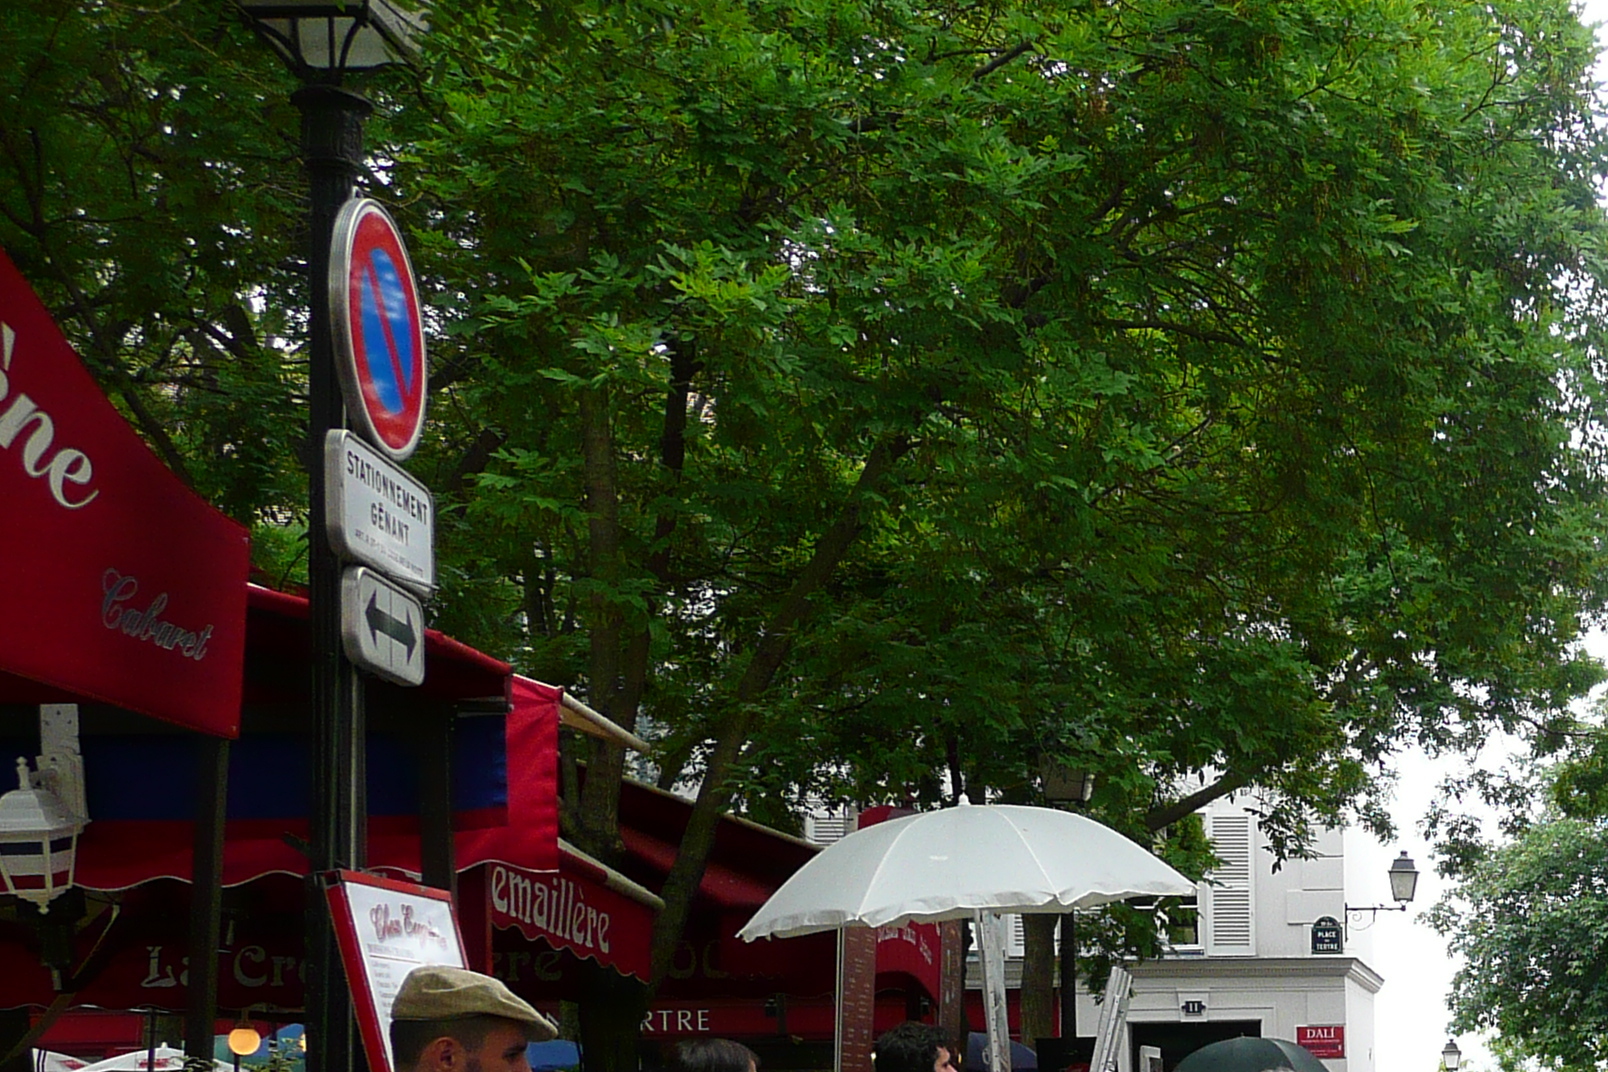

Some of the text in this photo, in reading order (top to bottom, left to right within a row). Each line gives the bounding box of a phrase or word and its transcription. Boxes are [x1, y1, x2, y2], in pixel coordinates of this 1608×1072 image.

[347, 450, 428, 526] STATIONNEMENT
[371, 501, 410, 546] GÊNANT
[102, 567, 214, 661] Cabaret
[491, 866, 611, 954] emaillère
